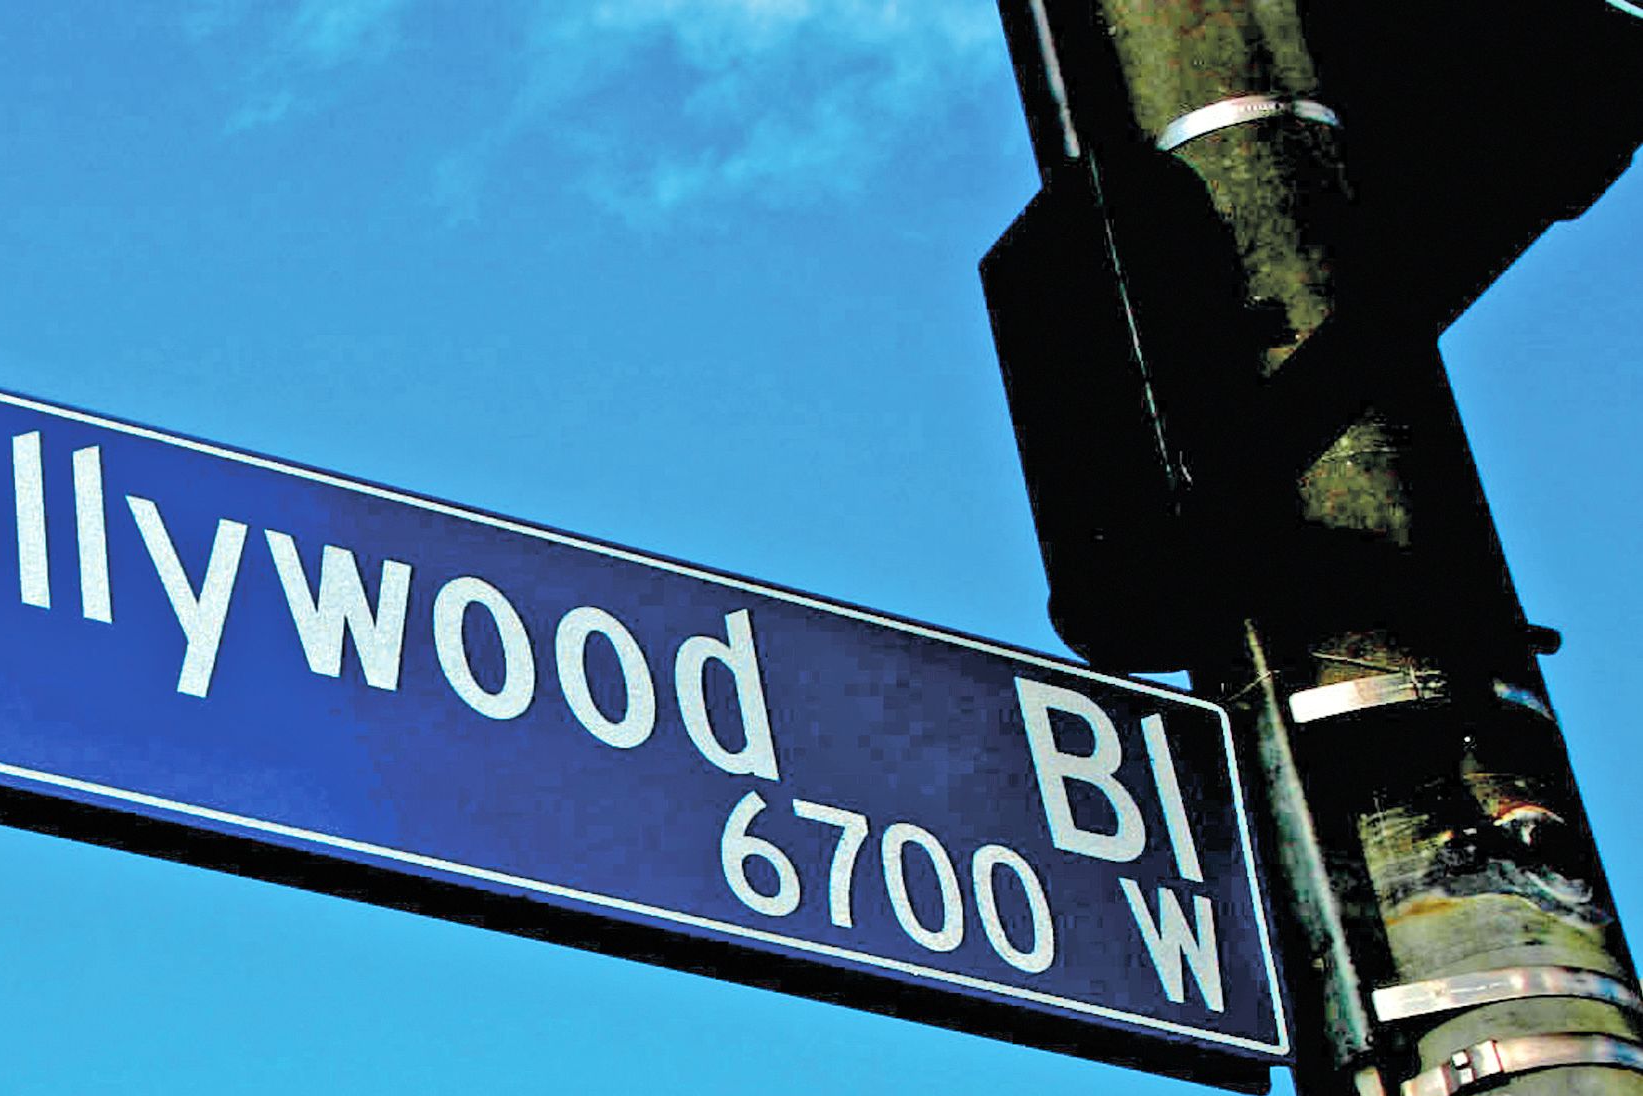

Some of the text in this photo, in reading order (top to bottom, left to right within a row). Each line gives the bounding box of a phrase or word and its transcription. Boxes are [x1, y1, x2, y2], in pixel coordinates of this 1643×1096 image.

[1013, 675, 1205, 884] Bl
[720, 790, 1226, 1014] 6700 W
